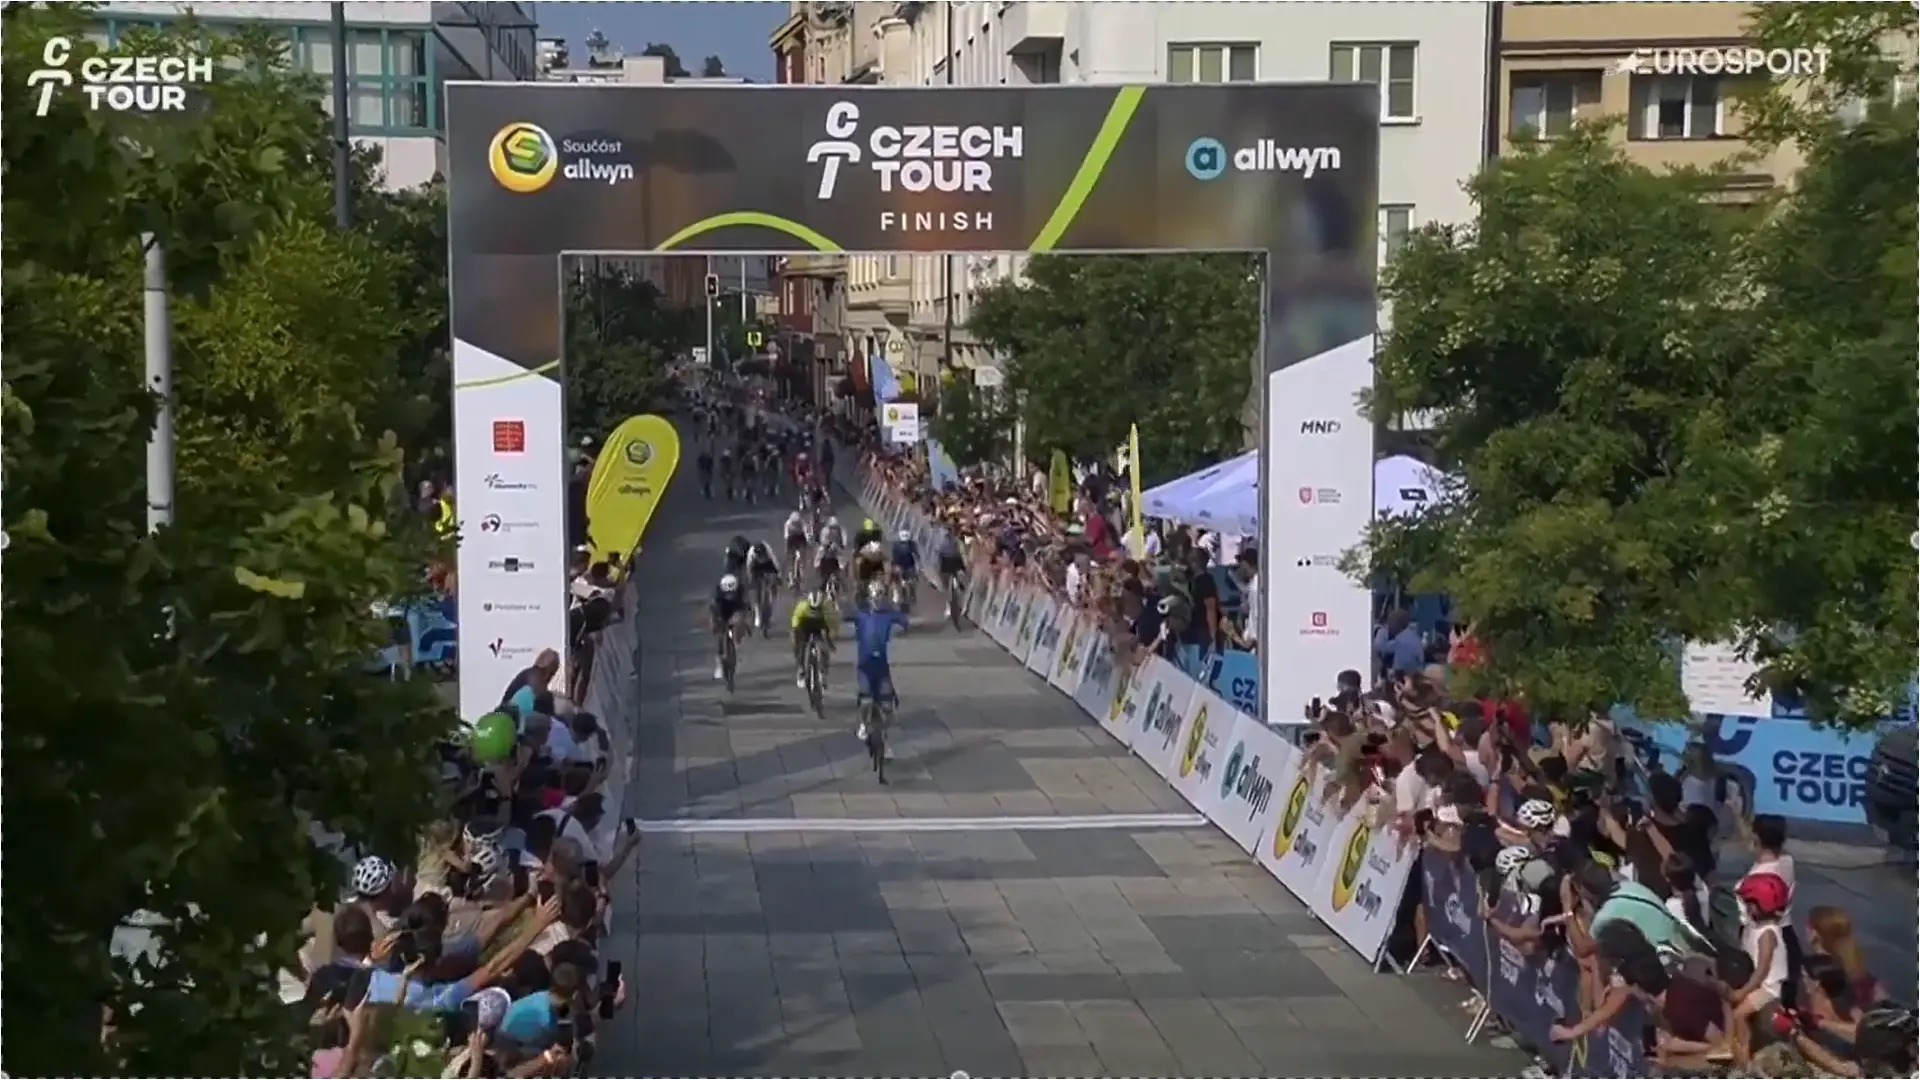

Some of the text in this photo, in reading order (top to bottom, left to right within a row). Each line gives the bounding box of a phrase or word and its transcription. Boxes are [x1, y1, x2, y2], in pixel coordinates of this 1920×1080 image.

[869, 125, 1023, 158] CZECH
[563, 158, 634, 185] allwyn
[1234, 139, 1341, 178] allwyn
[872, 160, 992, 192] TOUR
[881, 212, 992, 231] FINISH
[1772, 750, 1869, 780] CZEC
